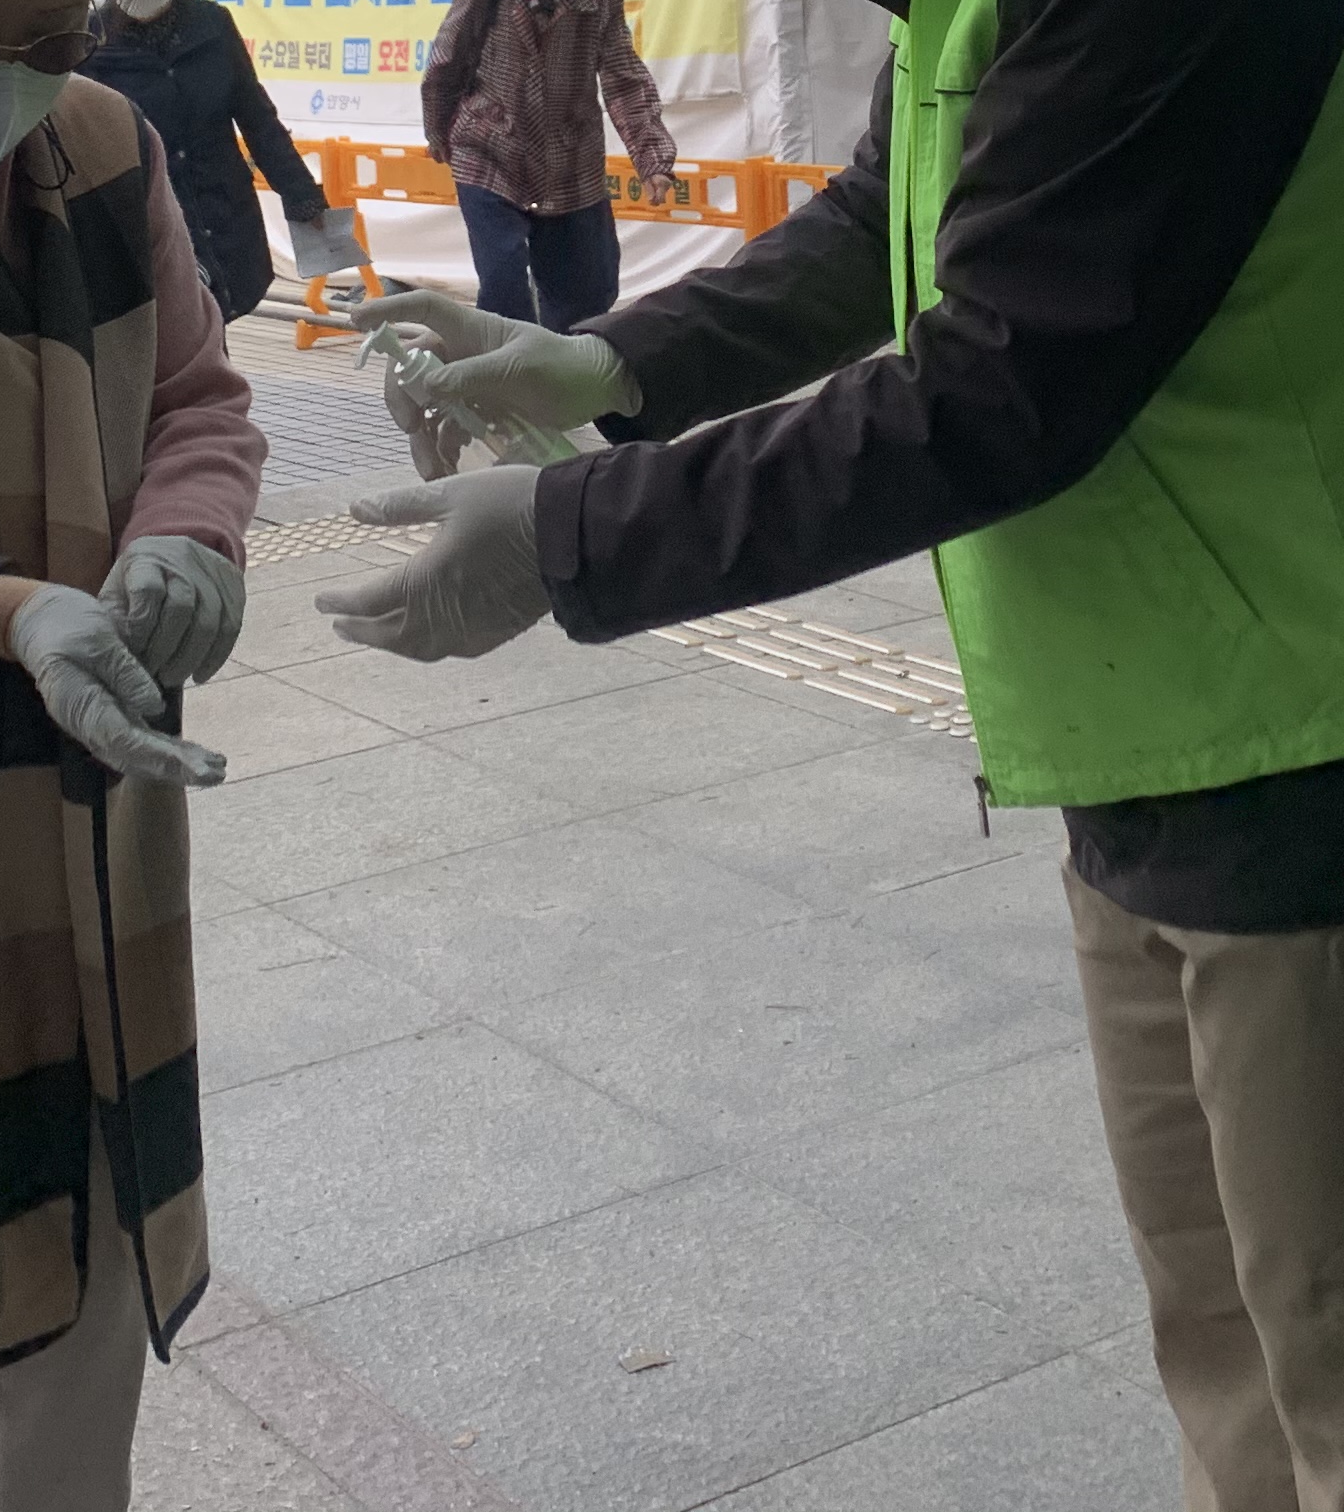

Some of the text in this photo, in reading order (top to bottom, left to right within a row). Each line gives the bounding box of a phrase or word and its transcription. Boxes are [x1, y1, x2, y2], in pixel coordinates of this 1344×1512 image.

[258, 40, 301, 70] 수요일
[304, 41, 332, 71] 부터
[345, 41, 369, 71] 평일
[378, 40, 410, 73] 오전
